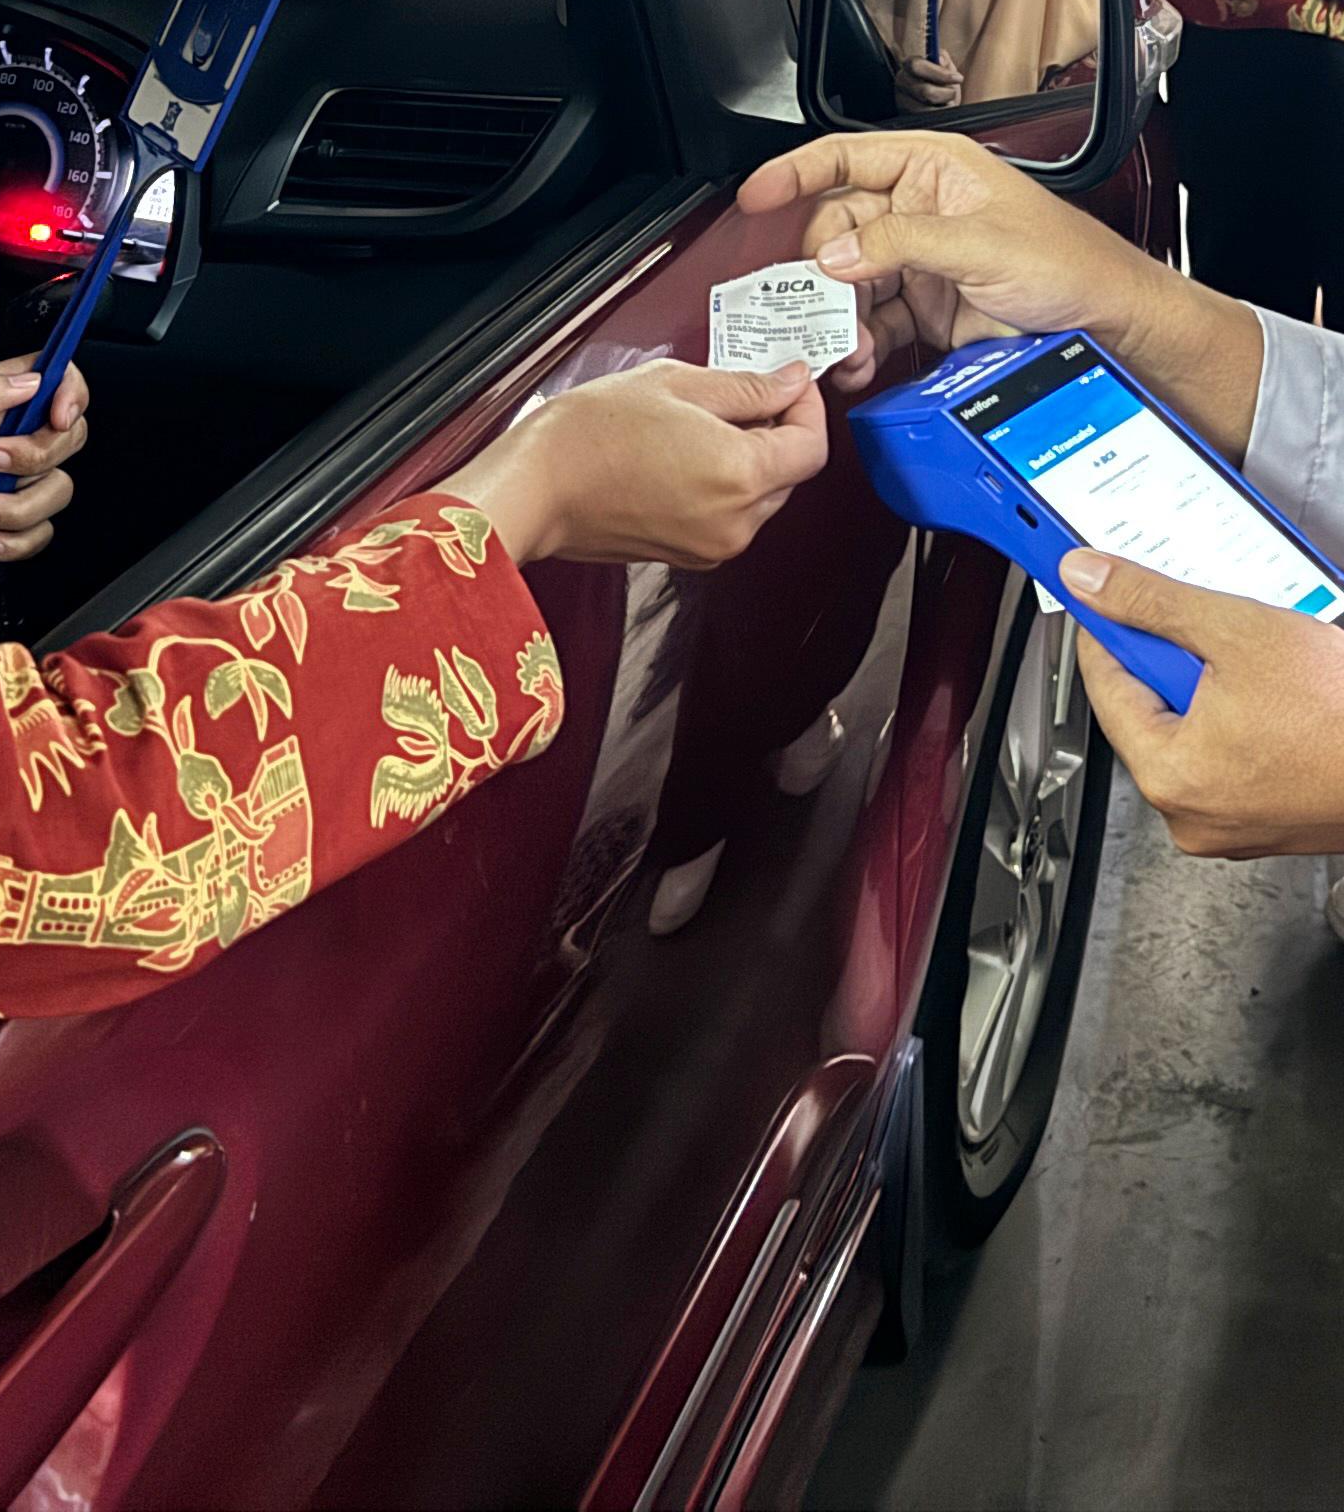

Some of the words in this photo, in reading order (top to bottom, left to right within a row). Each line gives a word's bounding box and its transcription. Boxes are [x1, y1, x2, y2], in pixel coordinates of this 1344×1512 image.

[0, 73, 17, 85] 80
[32, 79, 54, 92] 100
[57, 101, 78, 115] 120
[69, 130, 90, 145] 140
[67, 169, 89, 183] 160
[53, 205, 73, 219] 180
[775, 280, 815, 293] BCA
[727, 350, 753, 361] TOTAL
[959, 394, 1000, 421] Verifone
